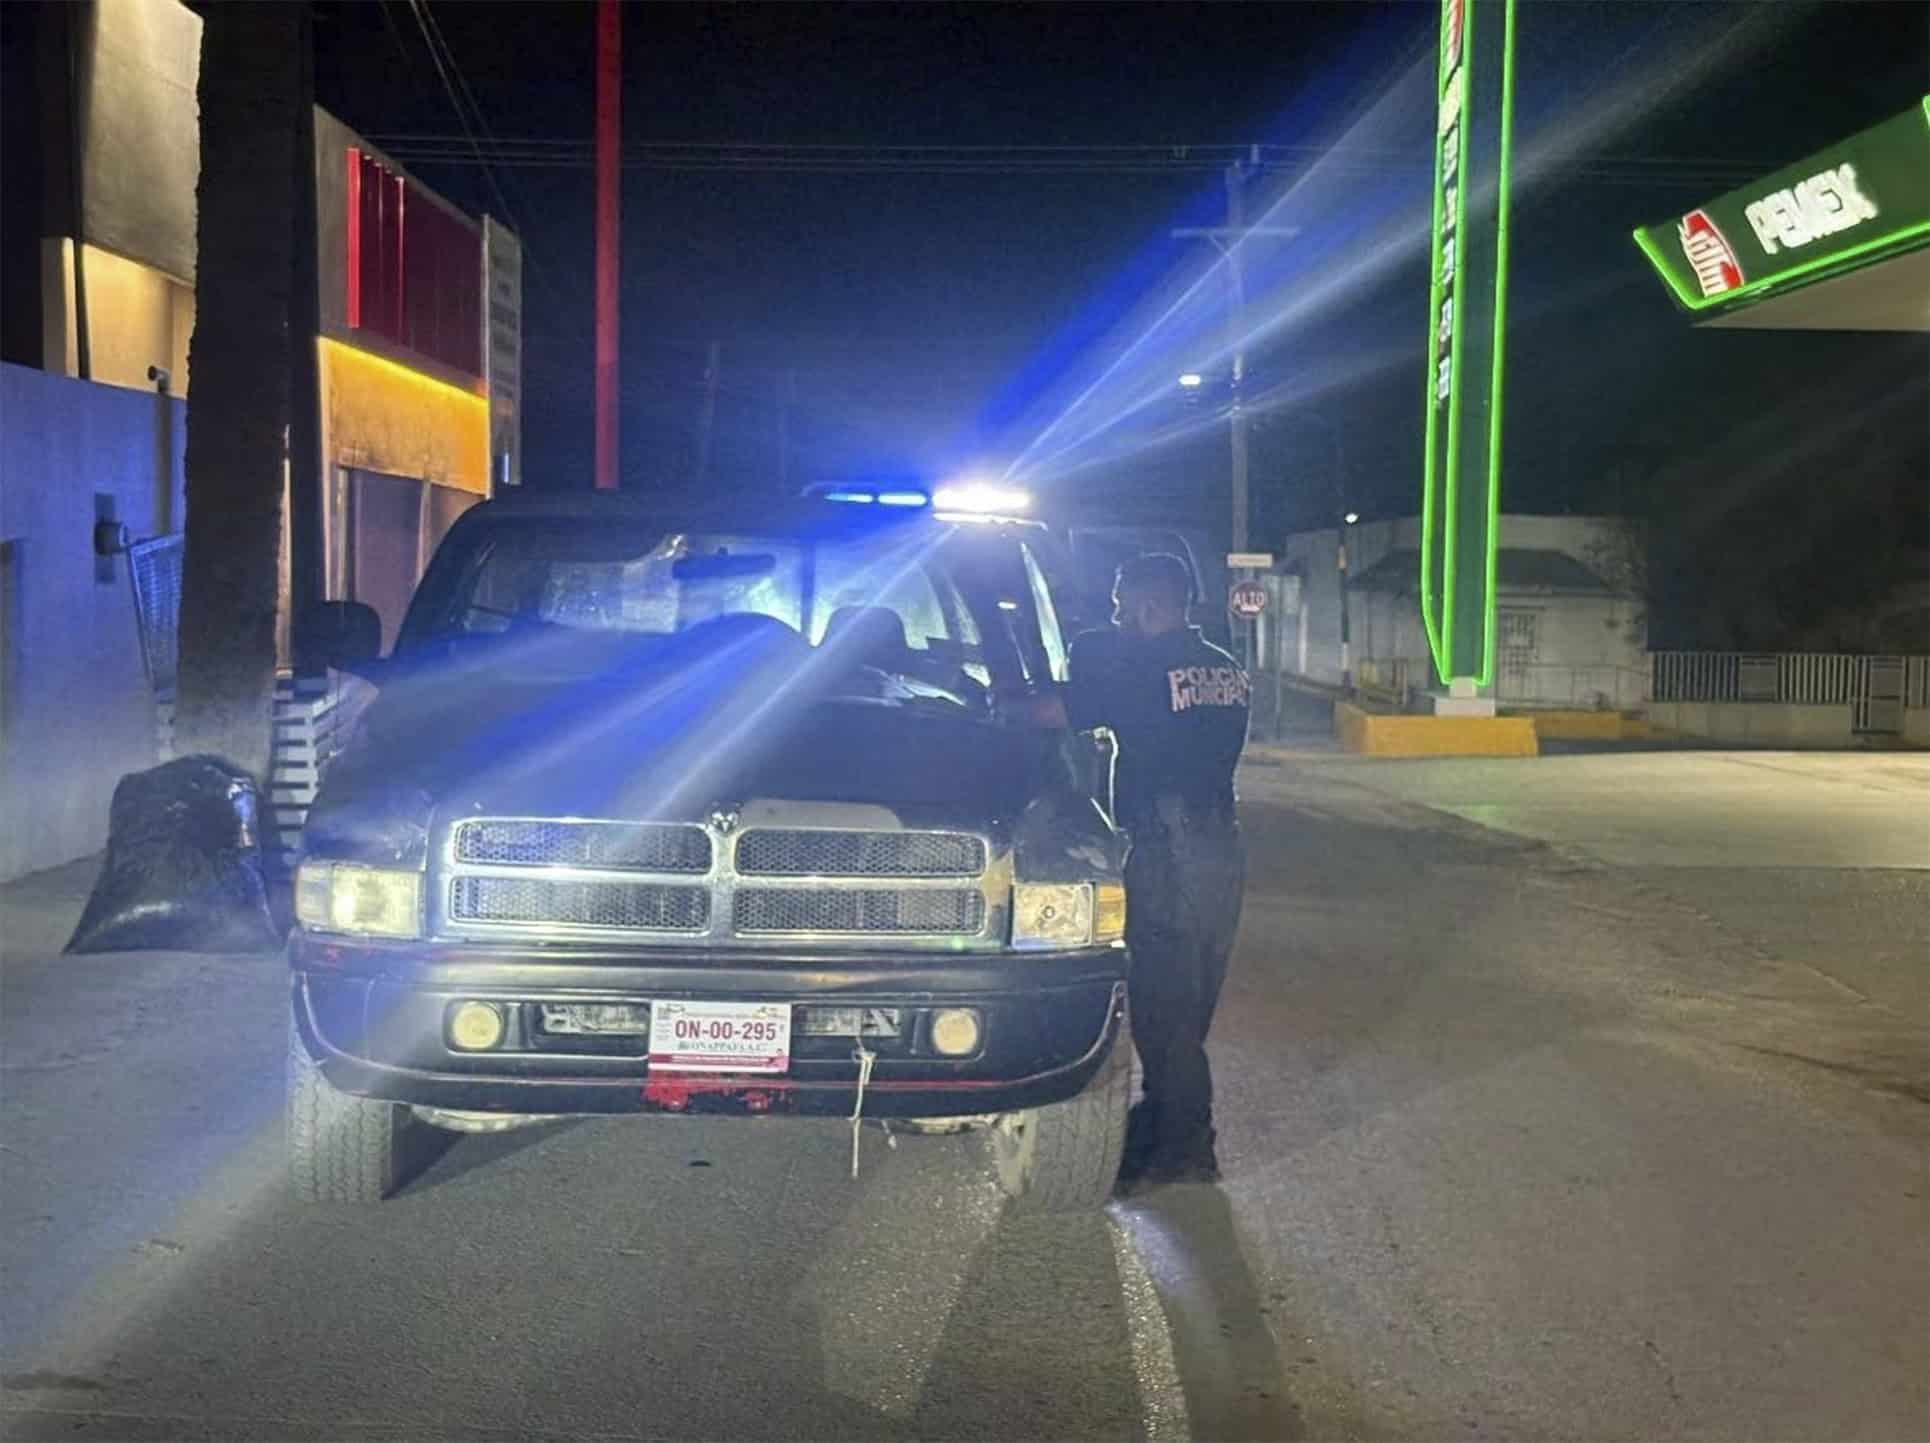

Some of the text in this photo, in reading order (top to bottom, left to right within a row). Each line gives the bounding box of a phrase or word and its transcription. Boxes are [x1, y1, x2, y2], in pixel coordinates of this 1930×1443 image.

[1745, 163, 1878, 254] PEMEX
[1171, 686, 1248, 712] MUCIPA
[675, 1019, 776, 1041] ON-00-295
